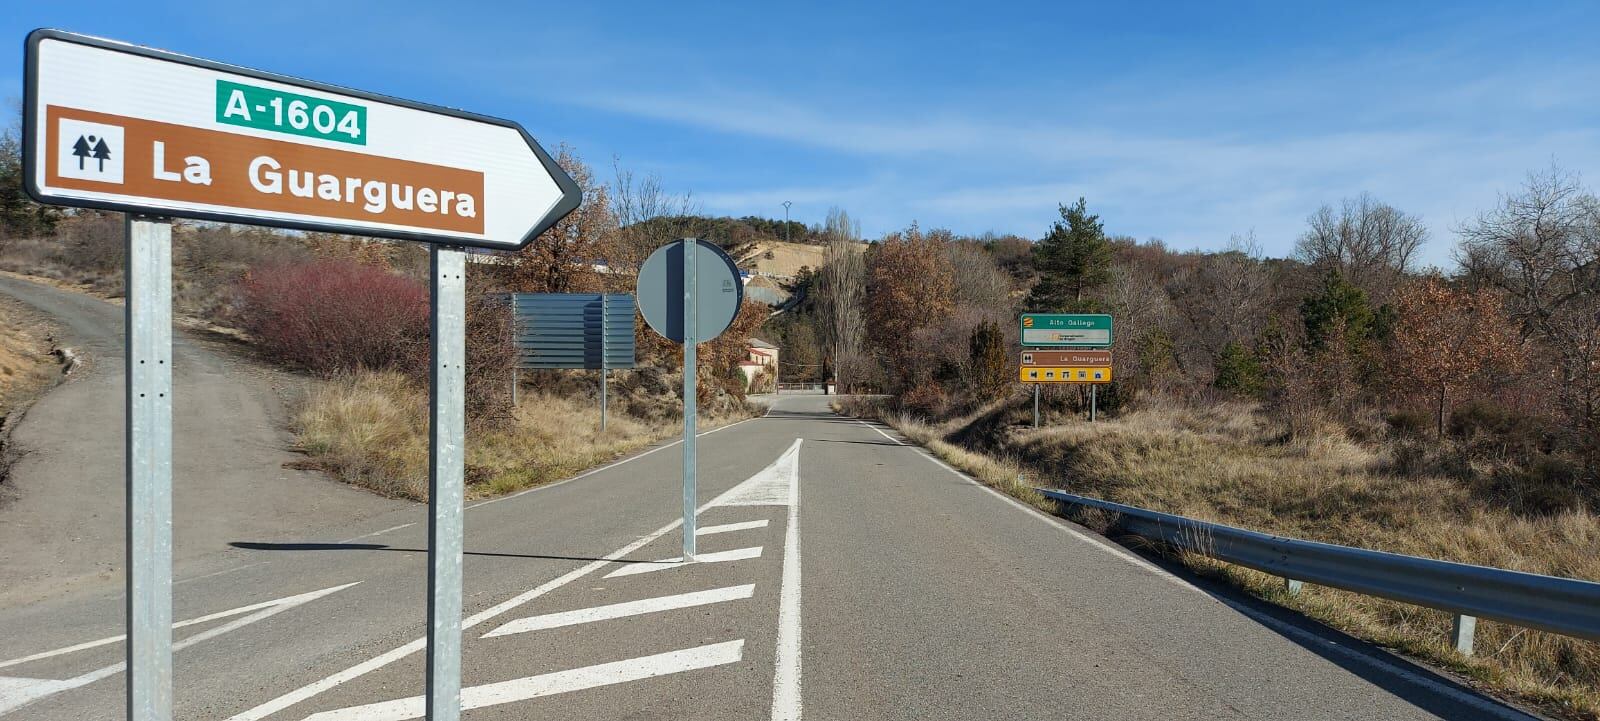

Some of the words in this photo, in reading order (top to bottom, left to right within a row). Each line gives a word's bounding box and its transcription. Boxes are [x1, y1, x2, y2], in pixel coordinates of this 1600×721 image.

[223, 89, 361, 139] A-1604
[153, 141, 213, 186] La
[248, 156, 477, 219] Guarguera
